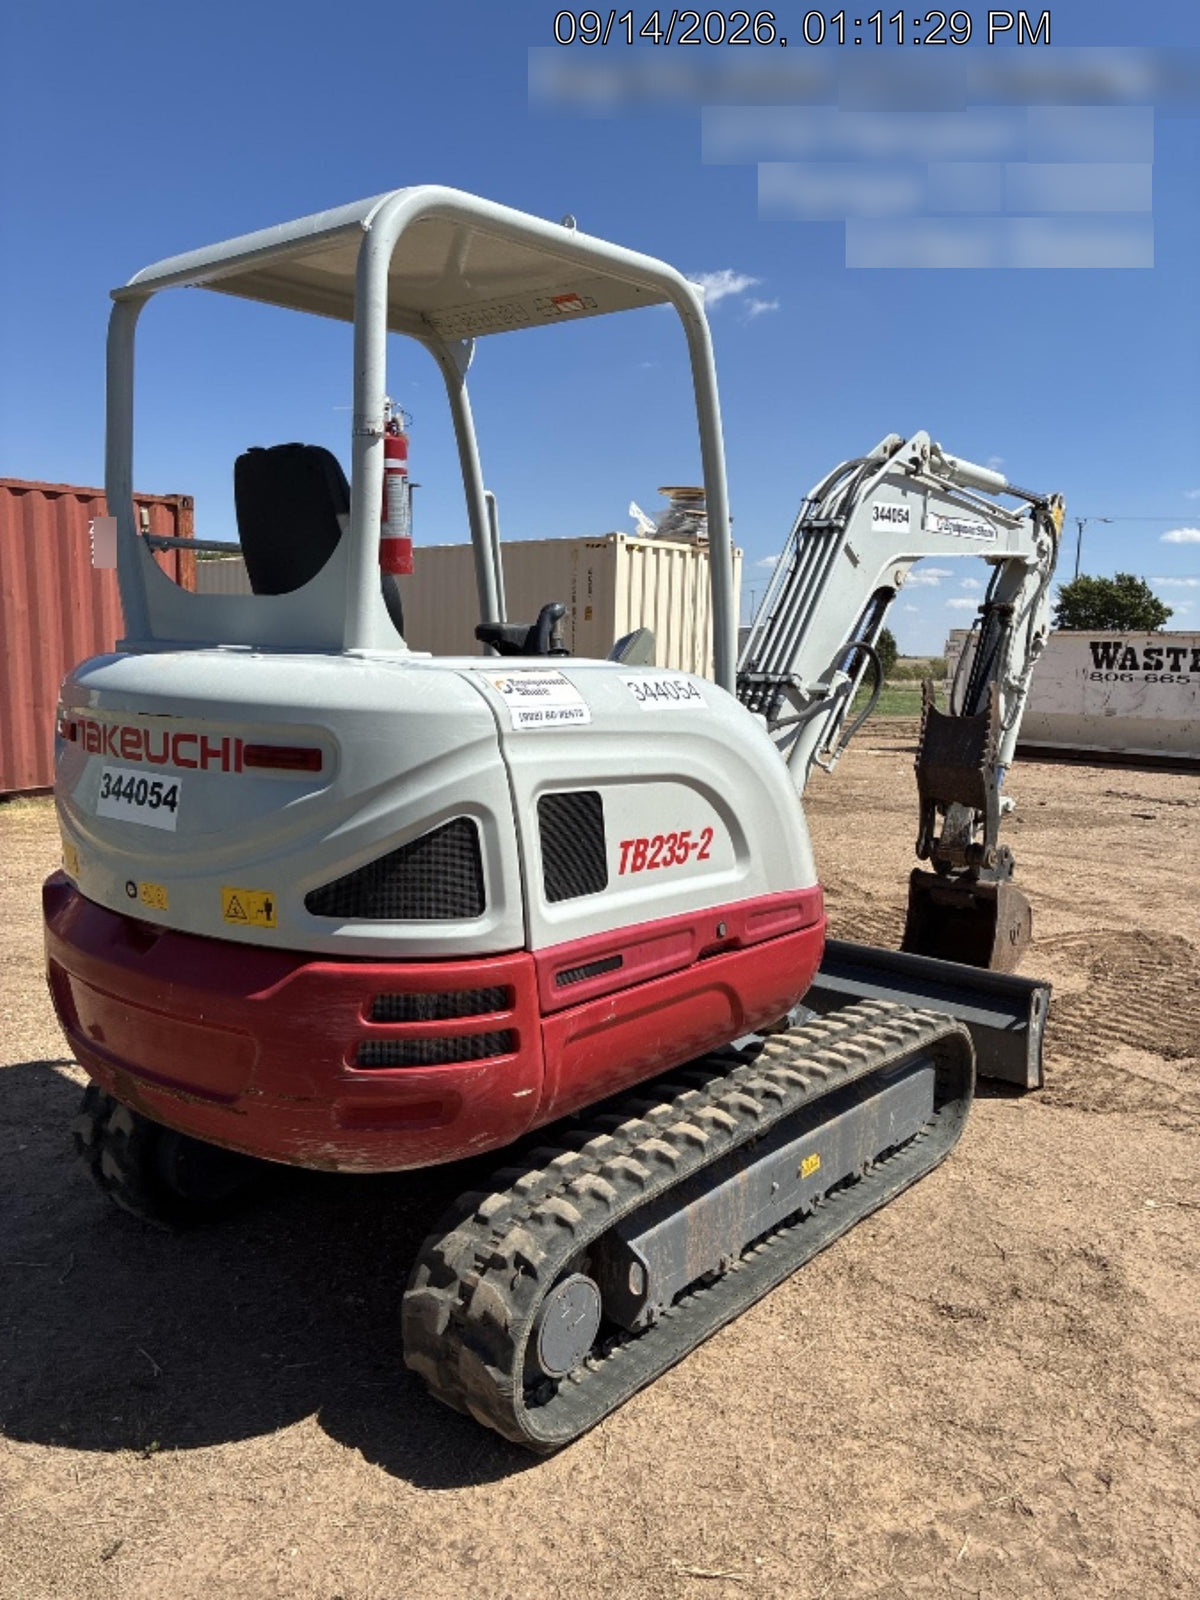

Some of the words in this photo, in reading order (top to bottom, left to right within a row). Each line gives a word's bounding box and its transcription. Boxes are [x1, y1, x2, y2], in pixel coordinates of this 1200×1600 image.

[872, 505, 909, 523] 344054
[1089, 671, 1134, 683] 806
[627, 681, 701, 702] 344054
[100, 773, 178, 812] 344054
[618, 826, 714, 876] TB235-2
